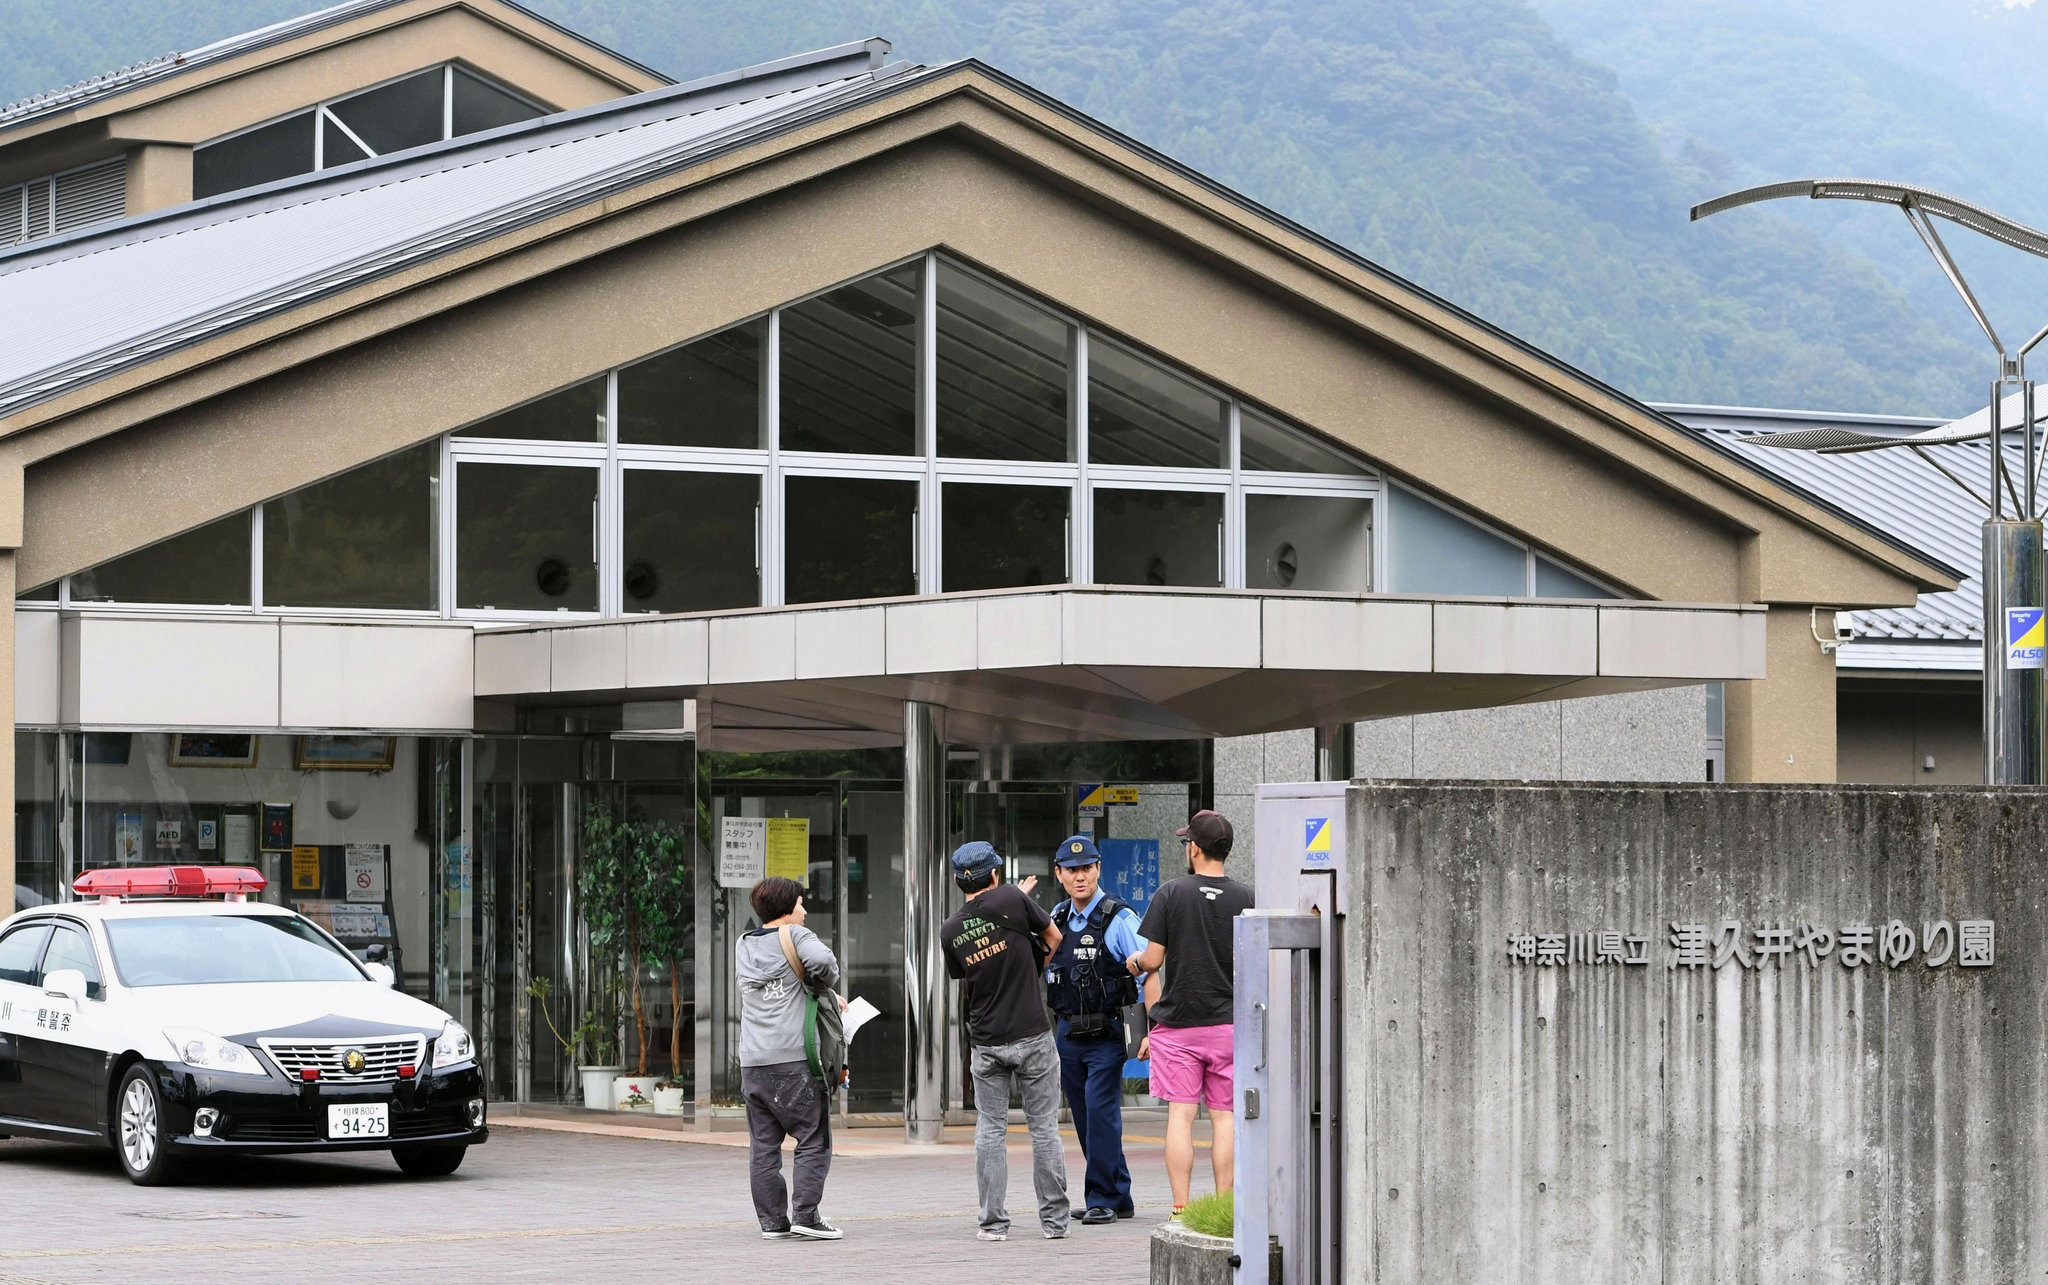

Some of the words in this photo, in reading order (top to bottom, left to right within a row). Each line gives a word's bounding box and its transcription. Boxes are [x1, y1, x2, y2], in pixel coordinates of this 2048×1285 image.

[158, 830, 179, 839] AED
[725, 829, 754, 838] スタッフ
[1306, 852, 1330, 861] ALSOK
[1132, 862, 1145, 917] 交通
[962, 917, 987, 930] FEE
[952, 922, 1000, 949] CONNECT
[974, 936, 990, 950] TO
[1507, 931, 1650, 967] 神奈川県立
[1667, 919, 1996, 970] 津久井やまゆり園
[965, 940, 1008, 966] NATURE
[37, 1008, 72, 1032] 県警察
[342, 1117, 385, 1135] 94-25
